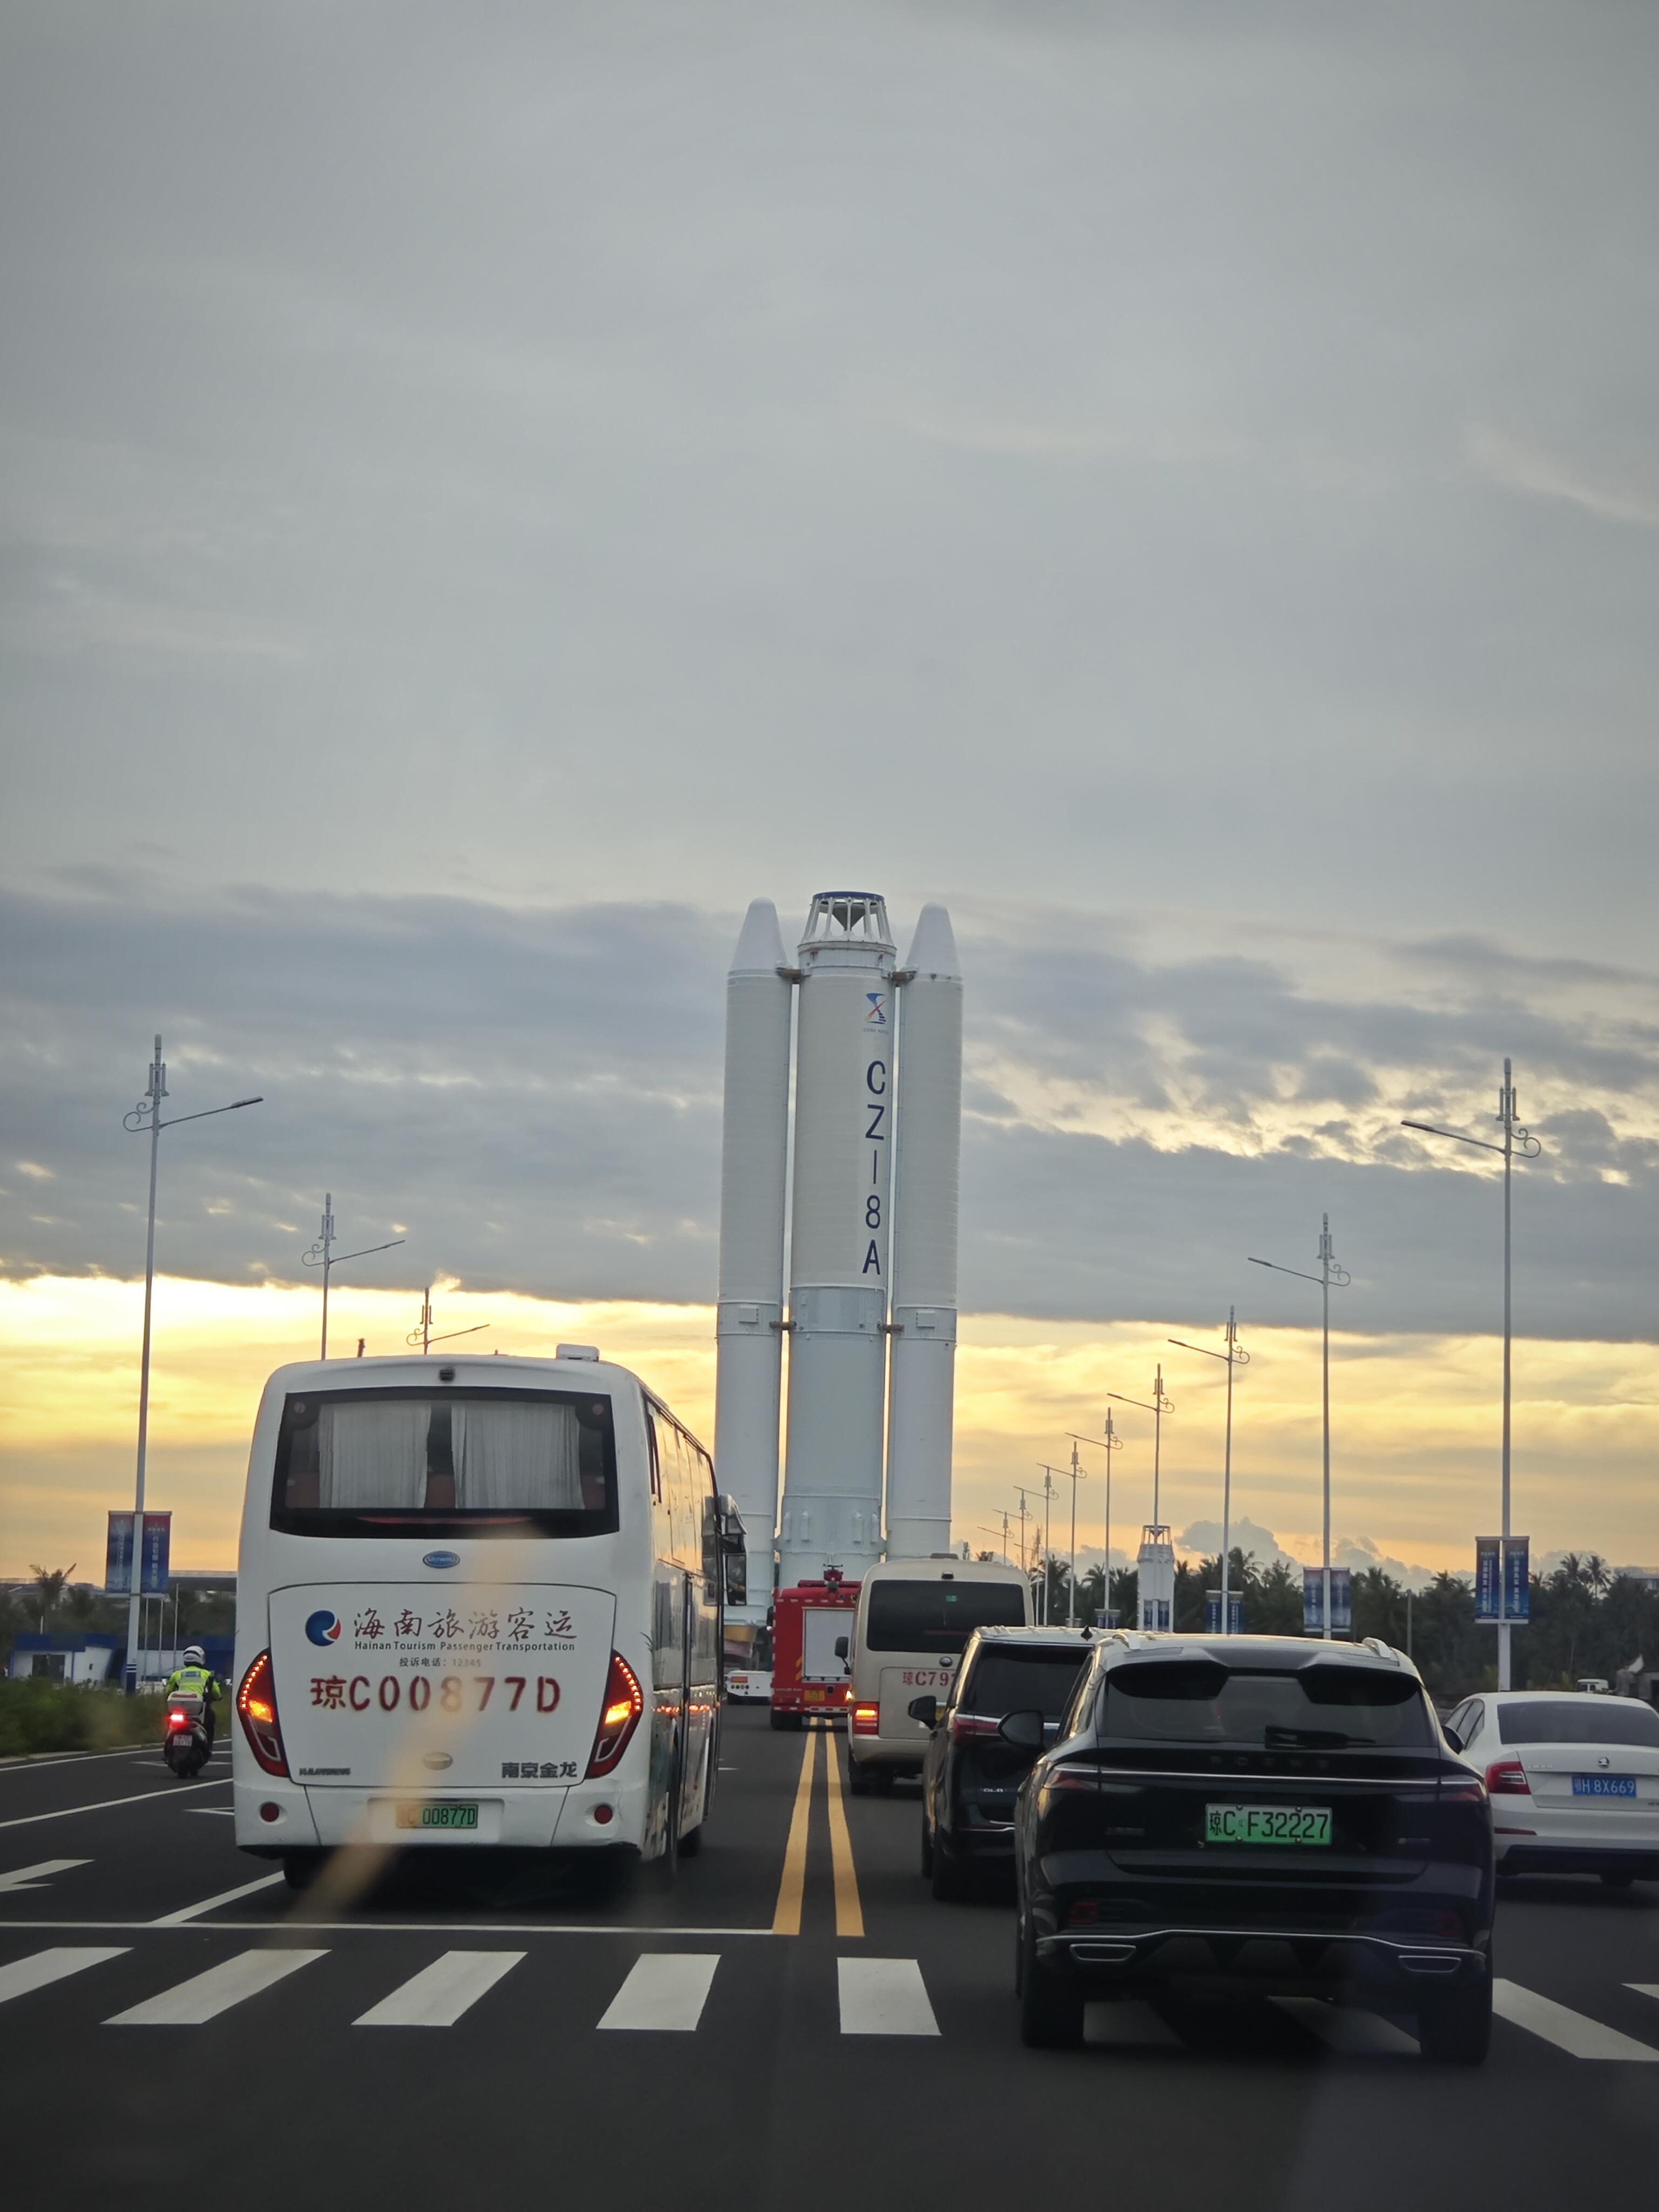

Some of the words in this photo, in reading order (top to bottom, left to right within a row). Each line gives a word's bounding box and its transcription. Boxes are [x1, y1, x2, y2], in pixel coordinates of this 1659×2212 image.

[354, 1607, 577, 1642] 海南旅游客运
[355, 1641, 391, 1650] Hainan
[394, 1641, 436, 1650] Tourism
[440, 1642, 494, 1653] Passenger
[496, 1642, 576, 1653] Transportation
[310, 1675, 561, 1713] 琼C00877D
[501, 1762, 577, 1778] 南京金龙
